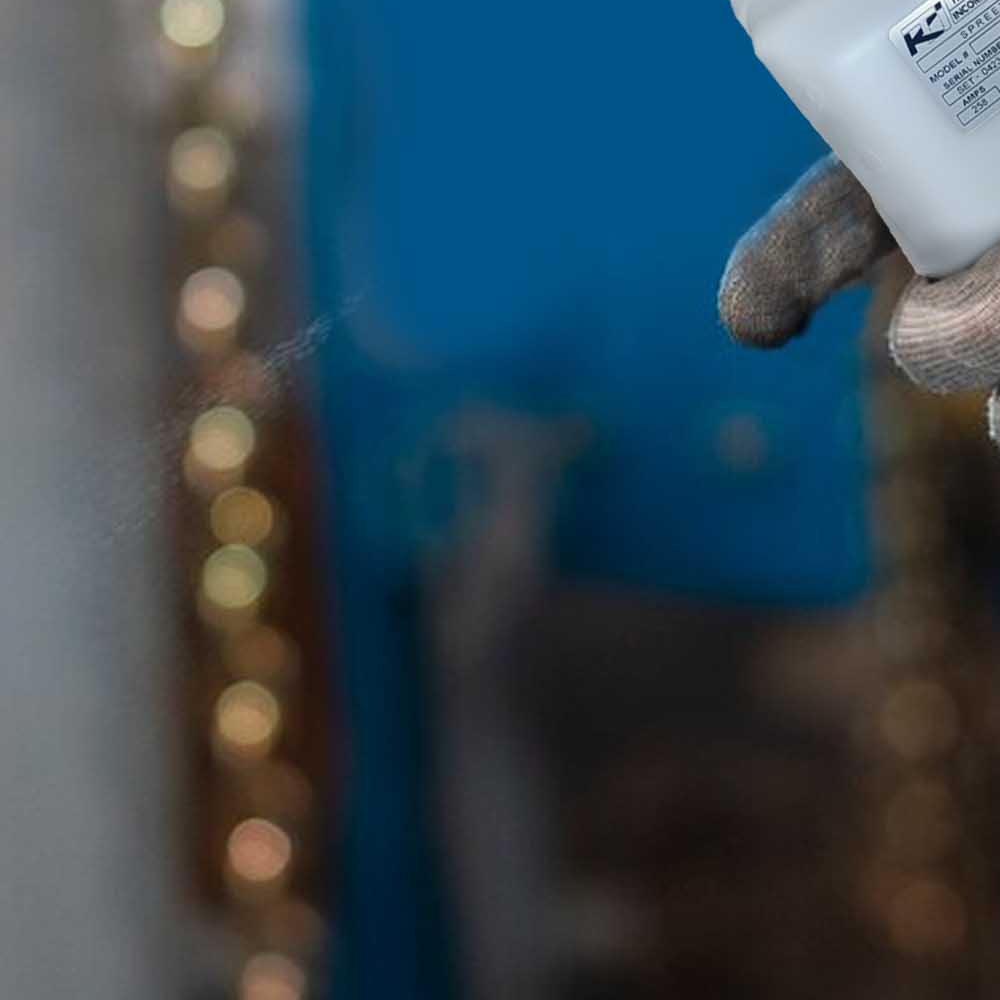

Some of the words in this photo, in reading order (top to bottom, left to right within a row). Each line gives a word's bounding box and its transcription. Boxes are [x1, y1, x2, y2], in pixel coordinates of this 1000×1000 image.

[929, 57, 963, 83] MODEL
[943, 66, 973, 89] SERIAL
[956, 77, 976, 94] SET
[962, 85, 986, 106] AMPS
